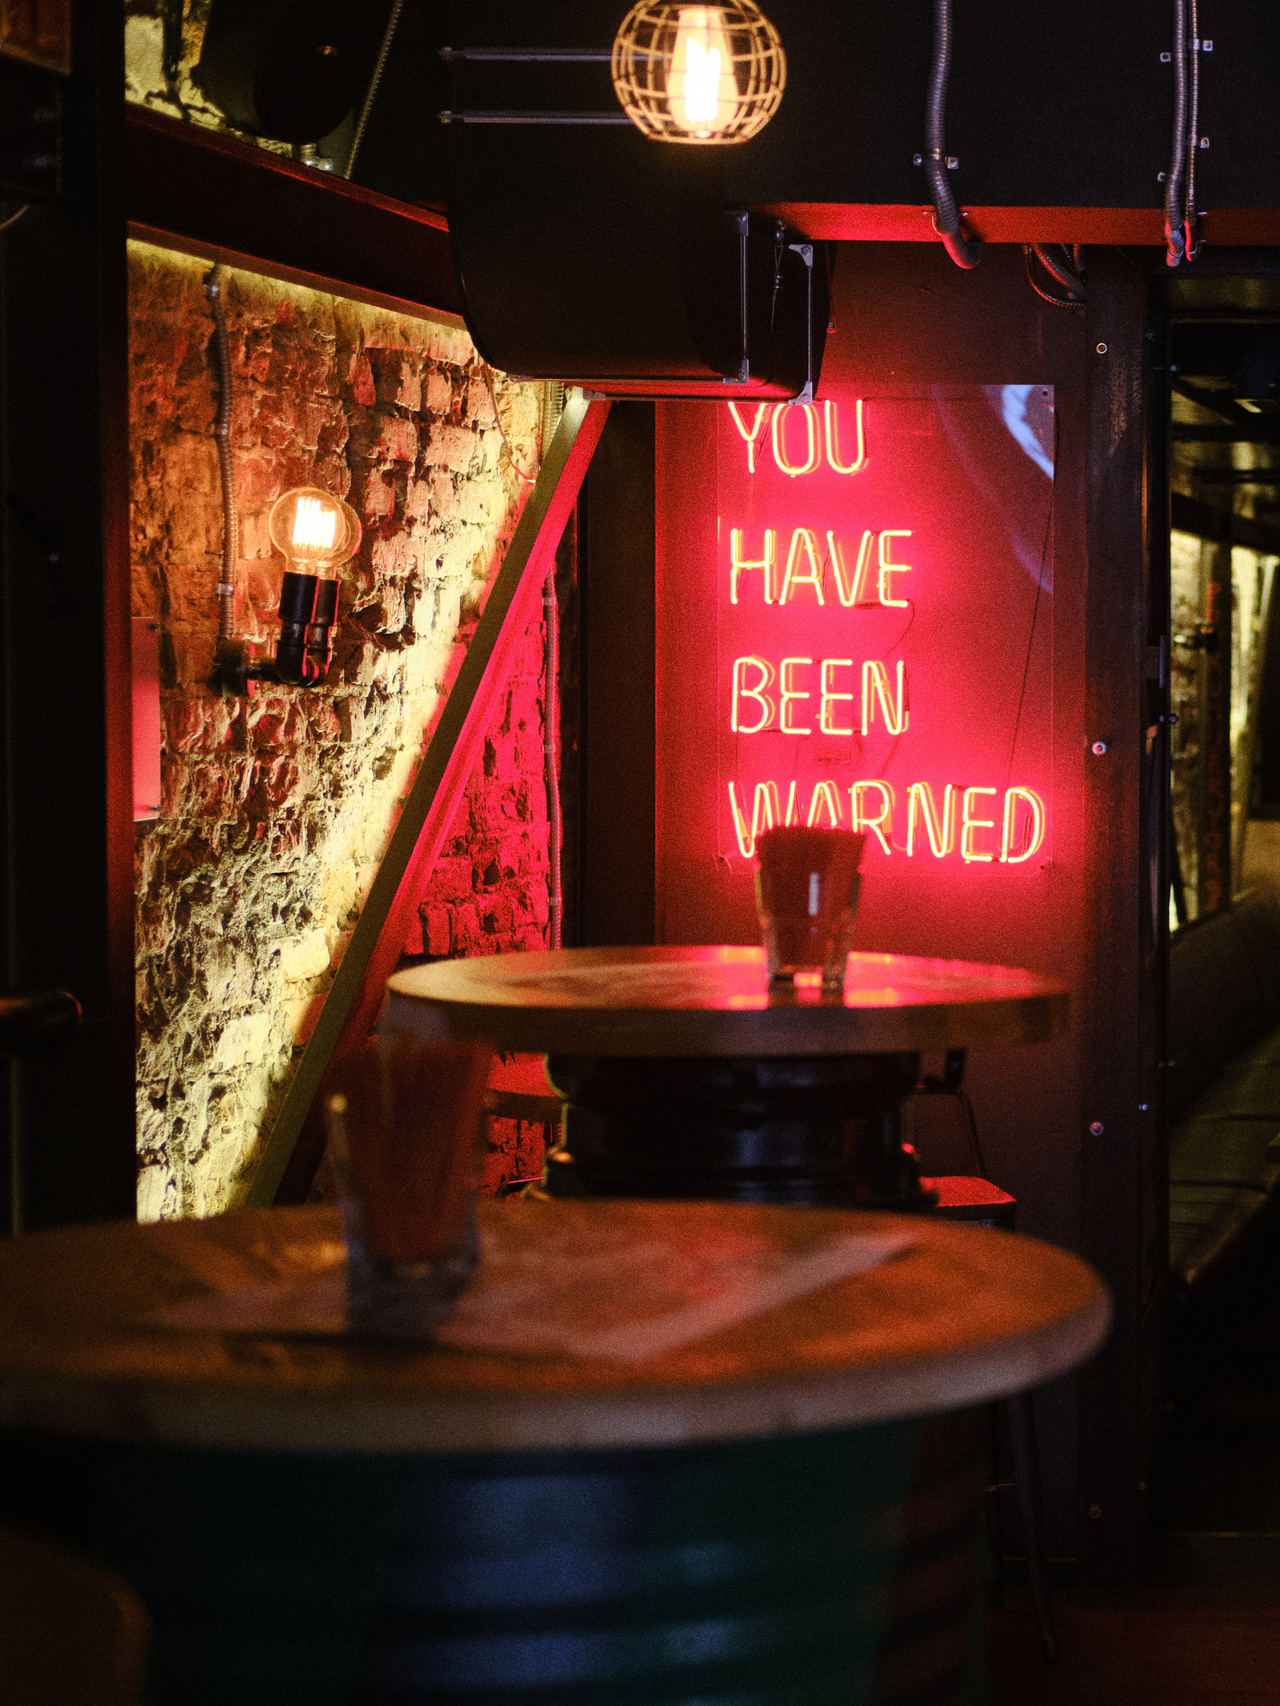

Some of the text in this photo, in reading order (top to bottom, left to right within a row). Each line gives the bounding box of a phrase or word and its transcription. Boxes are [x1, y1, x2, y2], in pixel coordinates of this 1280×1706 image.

[728, 399, 865, 474] YOU
[730, 528, 912, 607] HAVE
[731, 657, 905, 736] BEEN
[728, 780, 1046, 864] WARNED
